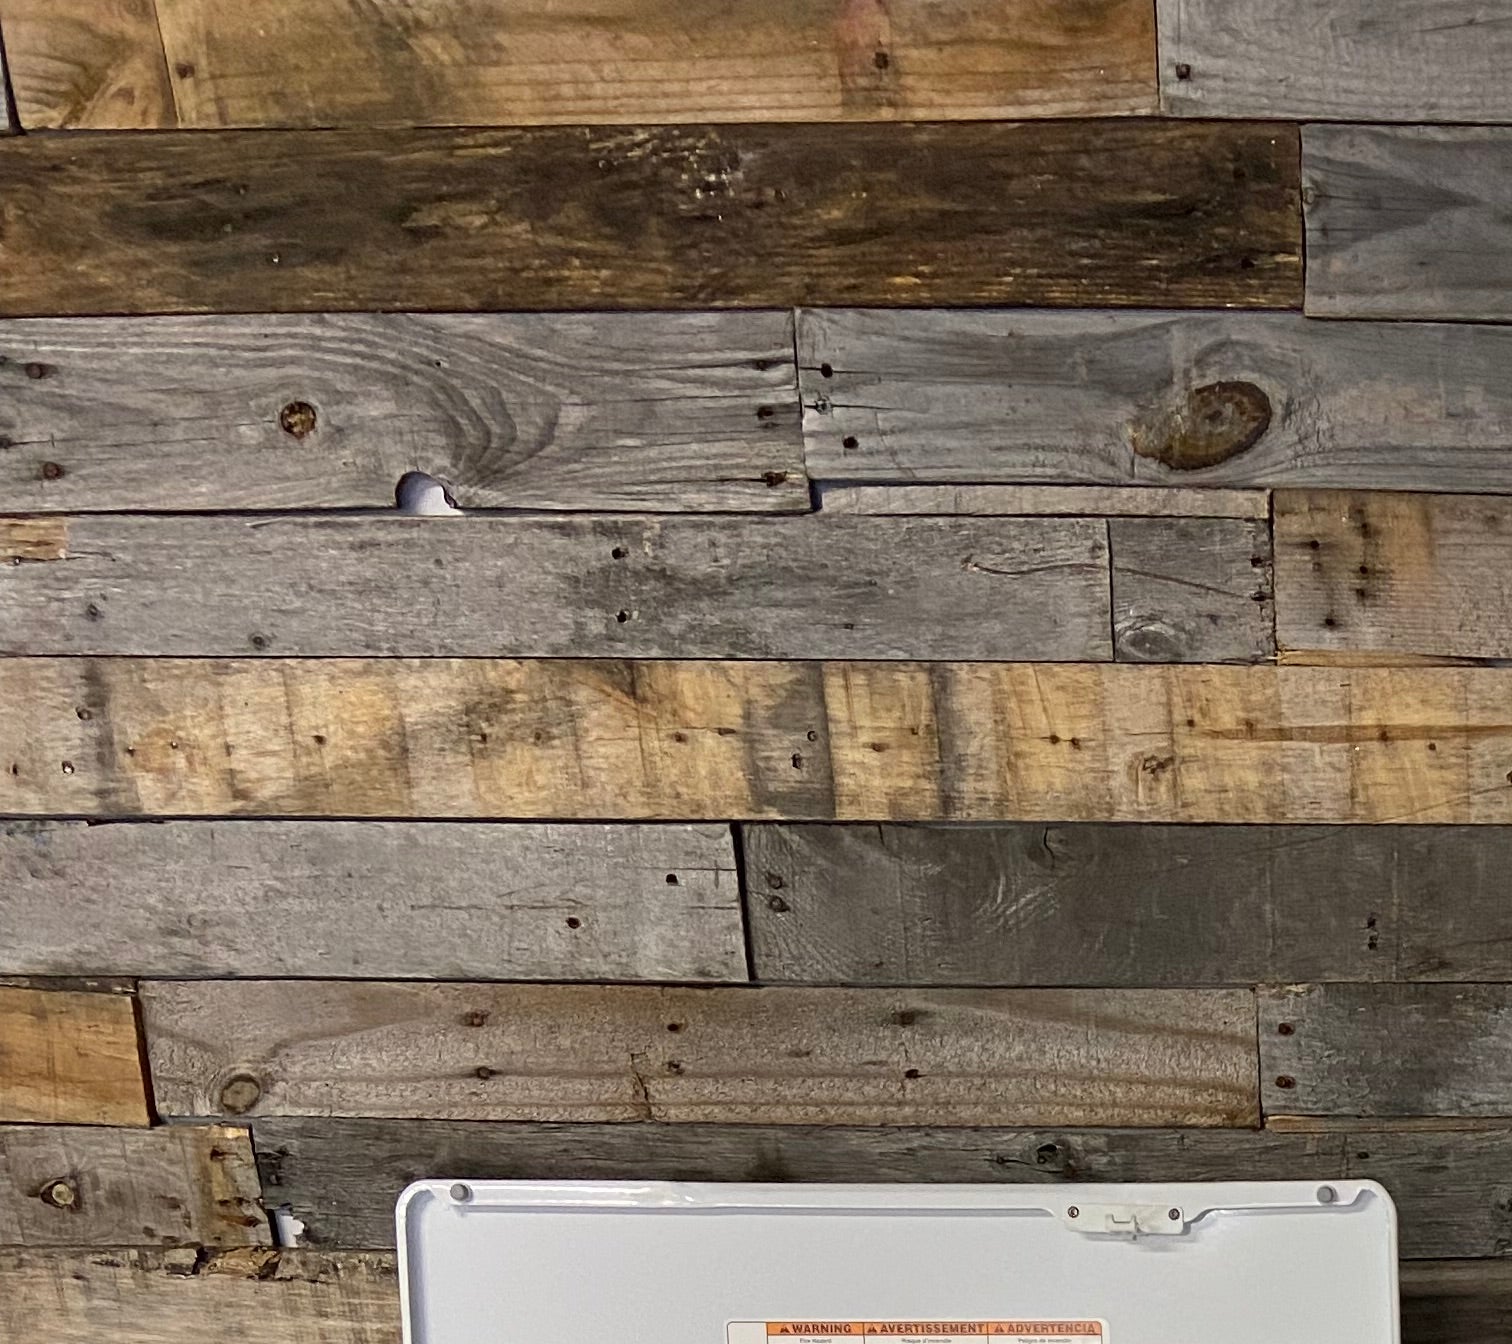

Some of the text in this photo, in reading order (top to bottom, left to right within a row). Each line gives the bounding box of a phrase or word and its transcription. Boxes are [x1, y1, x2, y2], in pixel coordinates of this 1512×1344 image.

[792, 1323, 852, 1334] WARNING
[880, 1323, 985, 1334] AVERTISSEMENT
[1007, 1323, 1096, 1334] ADVERTENCIA
